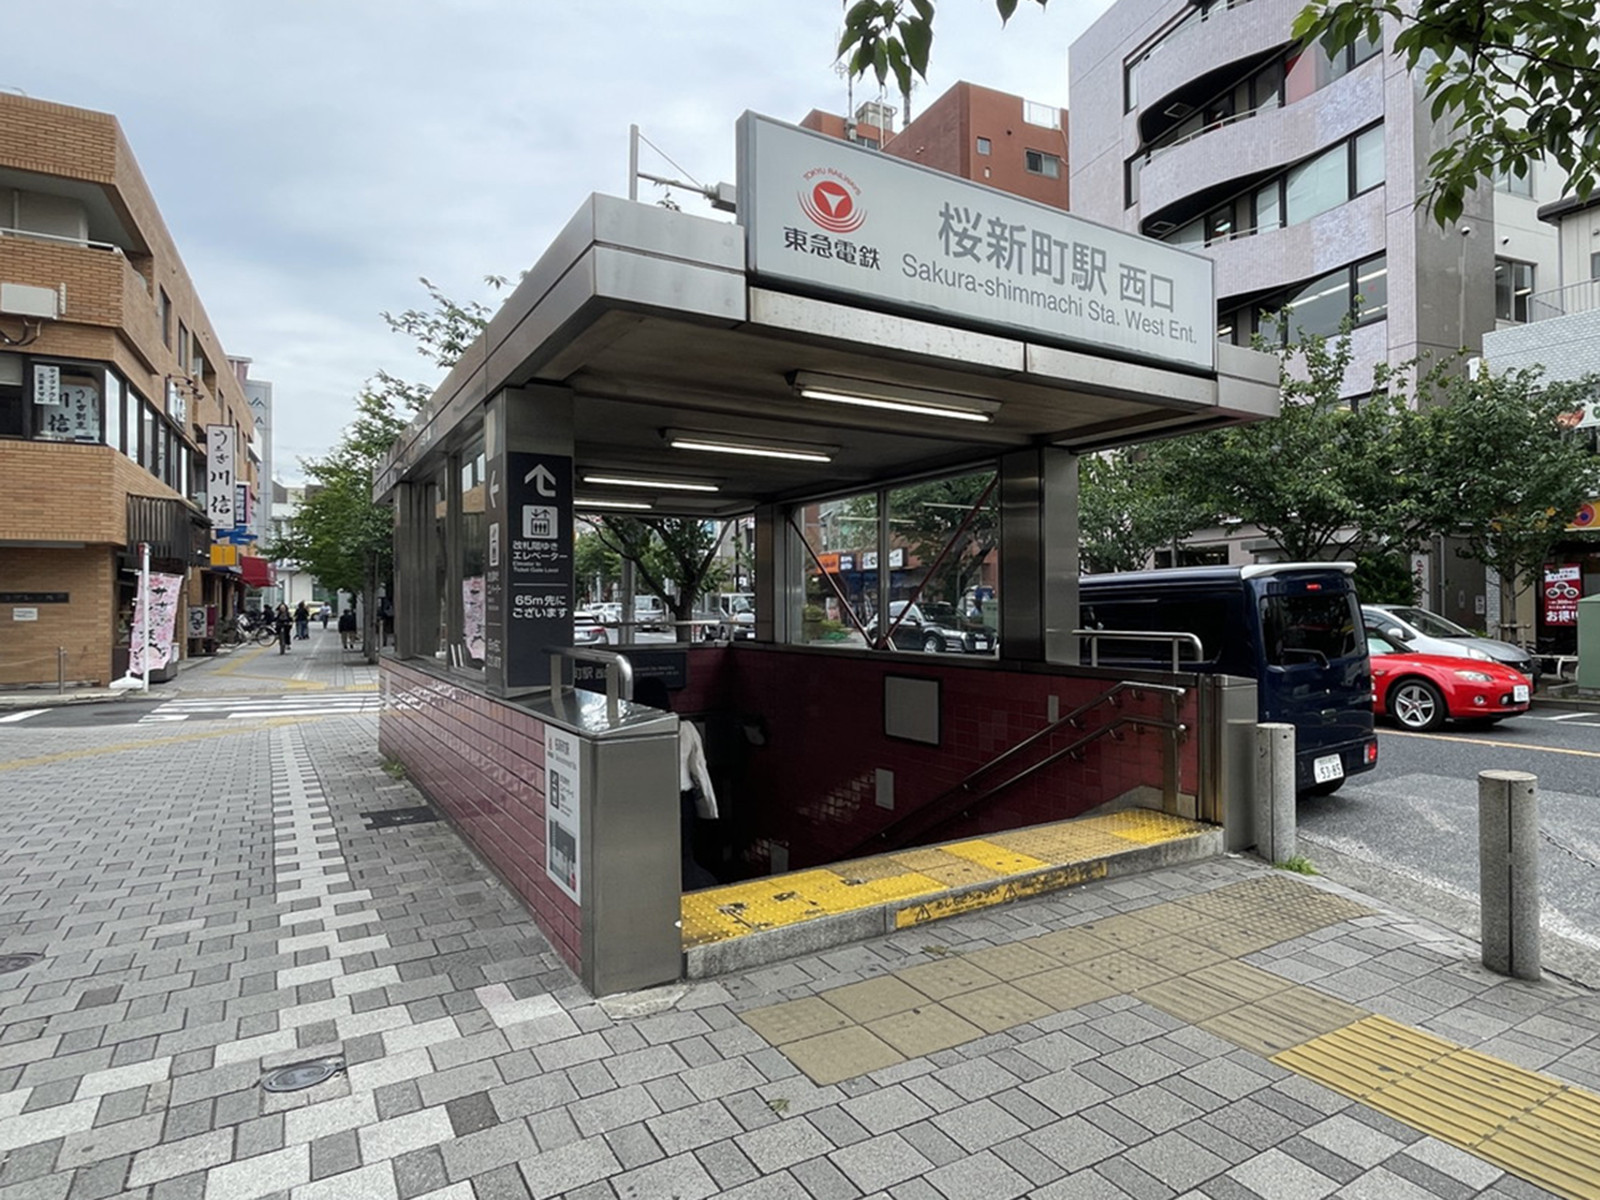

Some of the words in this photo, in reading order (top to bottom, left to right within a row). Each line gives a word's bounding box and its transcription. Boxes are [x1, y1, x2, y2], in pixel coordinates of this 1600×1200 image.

[803, 167, 826, 181] TOKYU
[783, 226, 881, 271] 東急電鉄
[938, 201, 1107, 296] 桜新町駅
[1119, 263, 1174, 313] 西口
[902, 253, 1083, 317] Sakura-shimmachi
[1088, 299, 1121, 327] Sta.
[1125, 308, 1165, 337] West
[1168, 319, 1198, 344] Ent.
[512, 551, 568, 561] エレベーター
[515, 594, 566, 606] 65m先に
[512, 607, 568, 618] ございます
